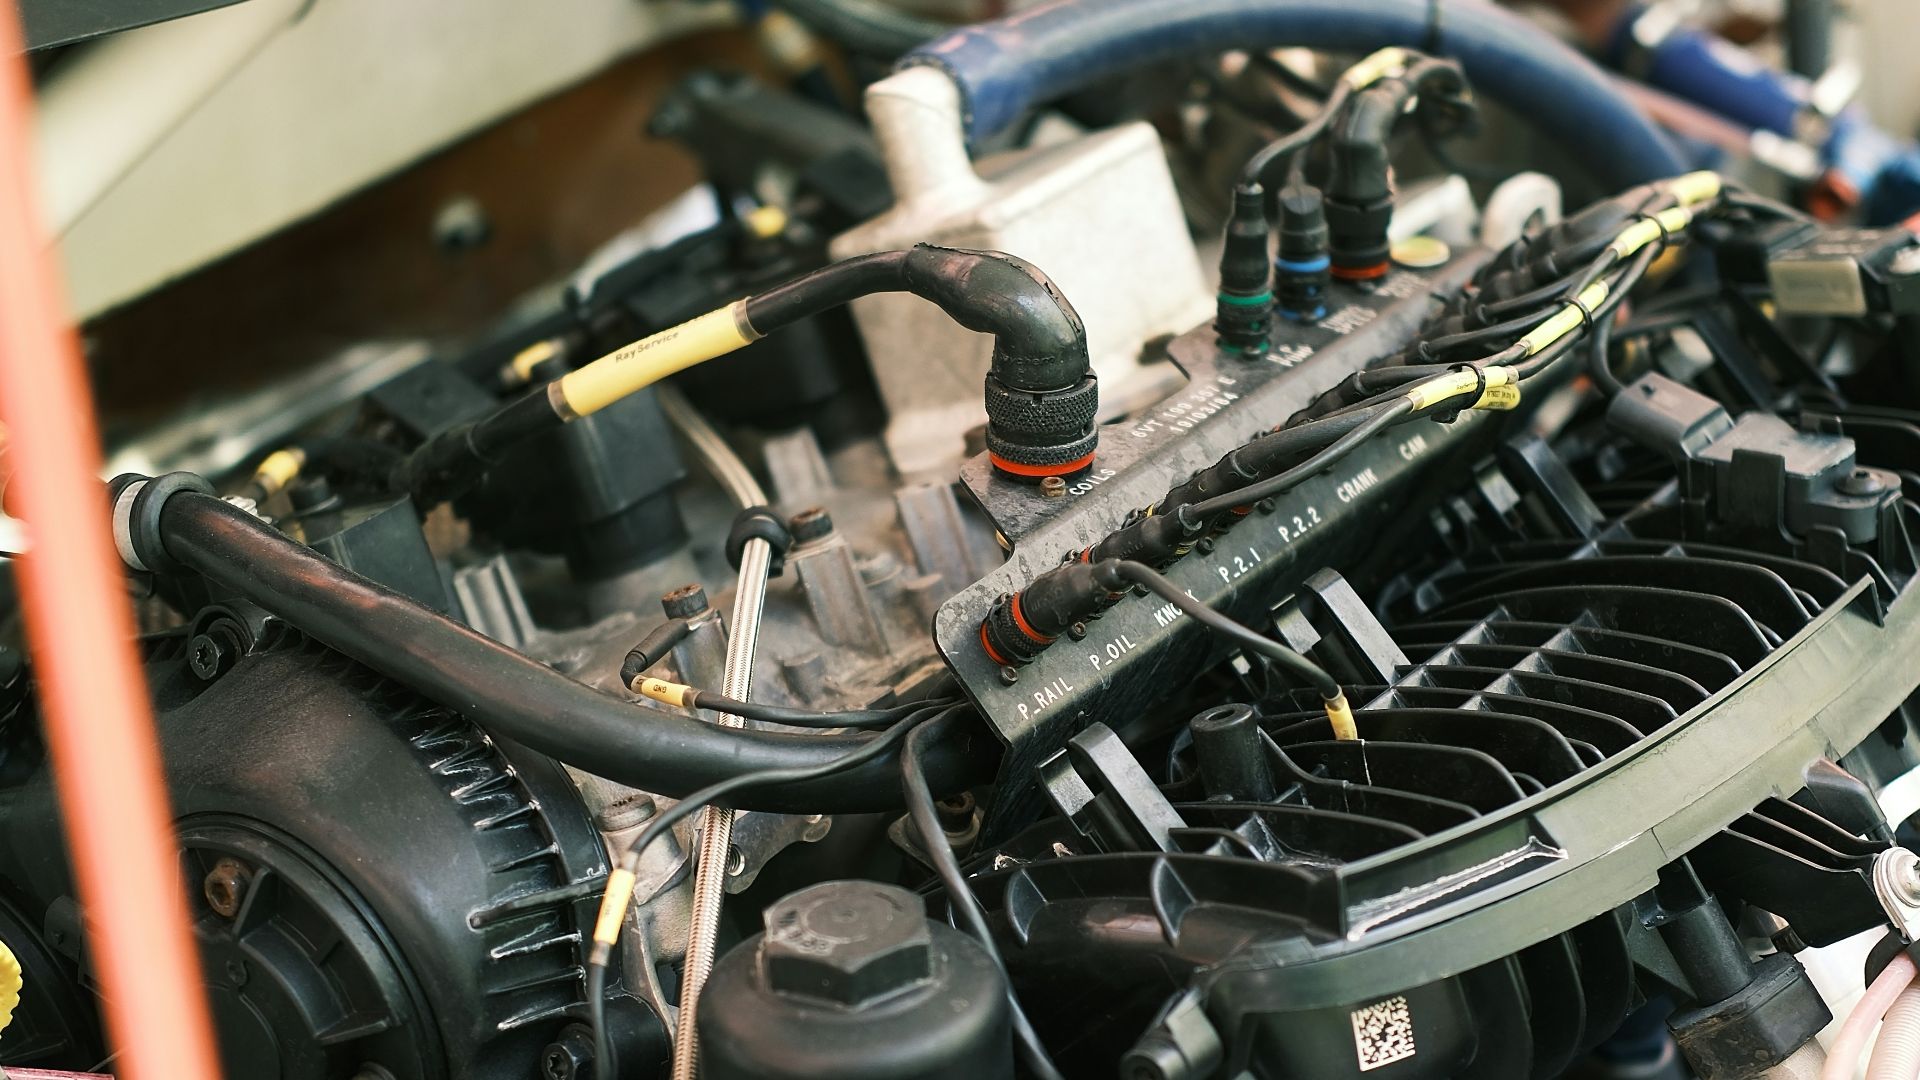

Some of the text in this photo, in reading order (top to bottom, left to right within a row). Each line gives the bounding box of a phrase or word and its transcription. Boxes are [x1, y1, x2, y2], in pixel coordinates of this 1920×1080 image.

[615, 331, 679, 363] RayService
[1130, 419, 1163, 438] 6VT
[1399, 433, 1427, 461] CAM
[1069, 468, 1117, 496] COILS
[1336, 468, 1379, 503] CRANK
[1278, 506, 1322, 543] P_2.2
[1218, 547, 1261, 583] P_2.1
[1089, 634, 1137, 671] P_OIL
[1017, 677, 1074, 720] P_RAIL
